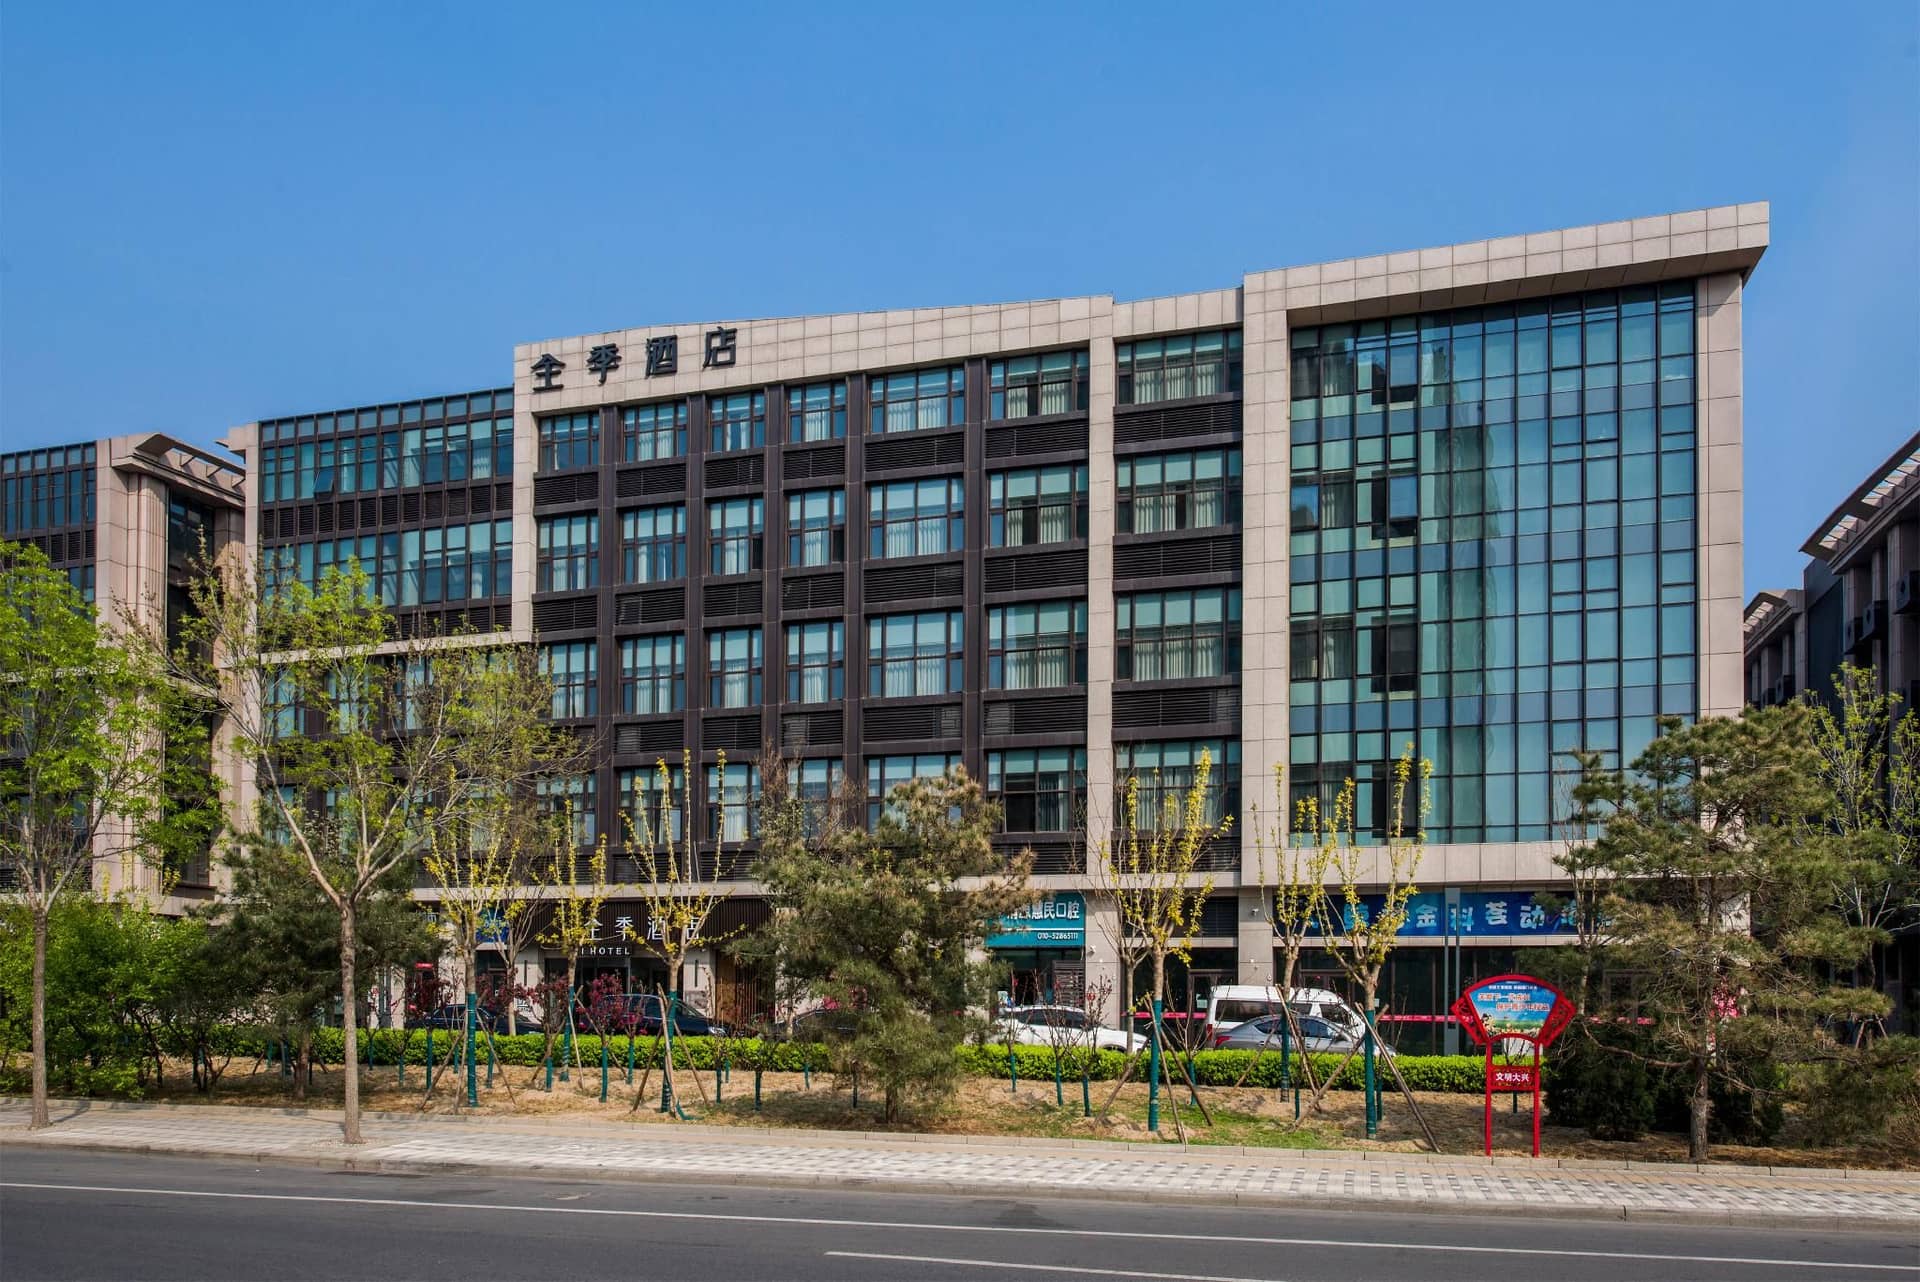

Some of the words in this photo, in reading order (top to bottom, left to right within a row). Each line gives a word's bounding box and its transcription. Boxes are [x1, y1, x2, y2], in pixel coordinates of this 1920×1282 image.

[530, 326, 738, 393] 全季酒店
[590, 947, 631, 955] HOTEL
[1495, 1072, 1530, 1082] 文明大兴
